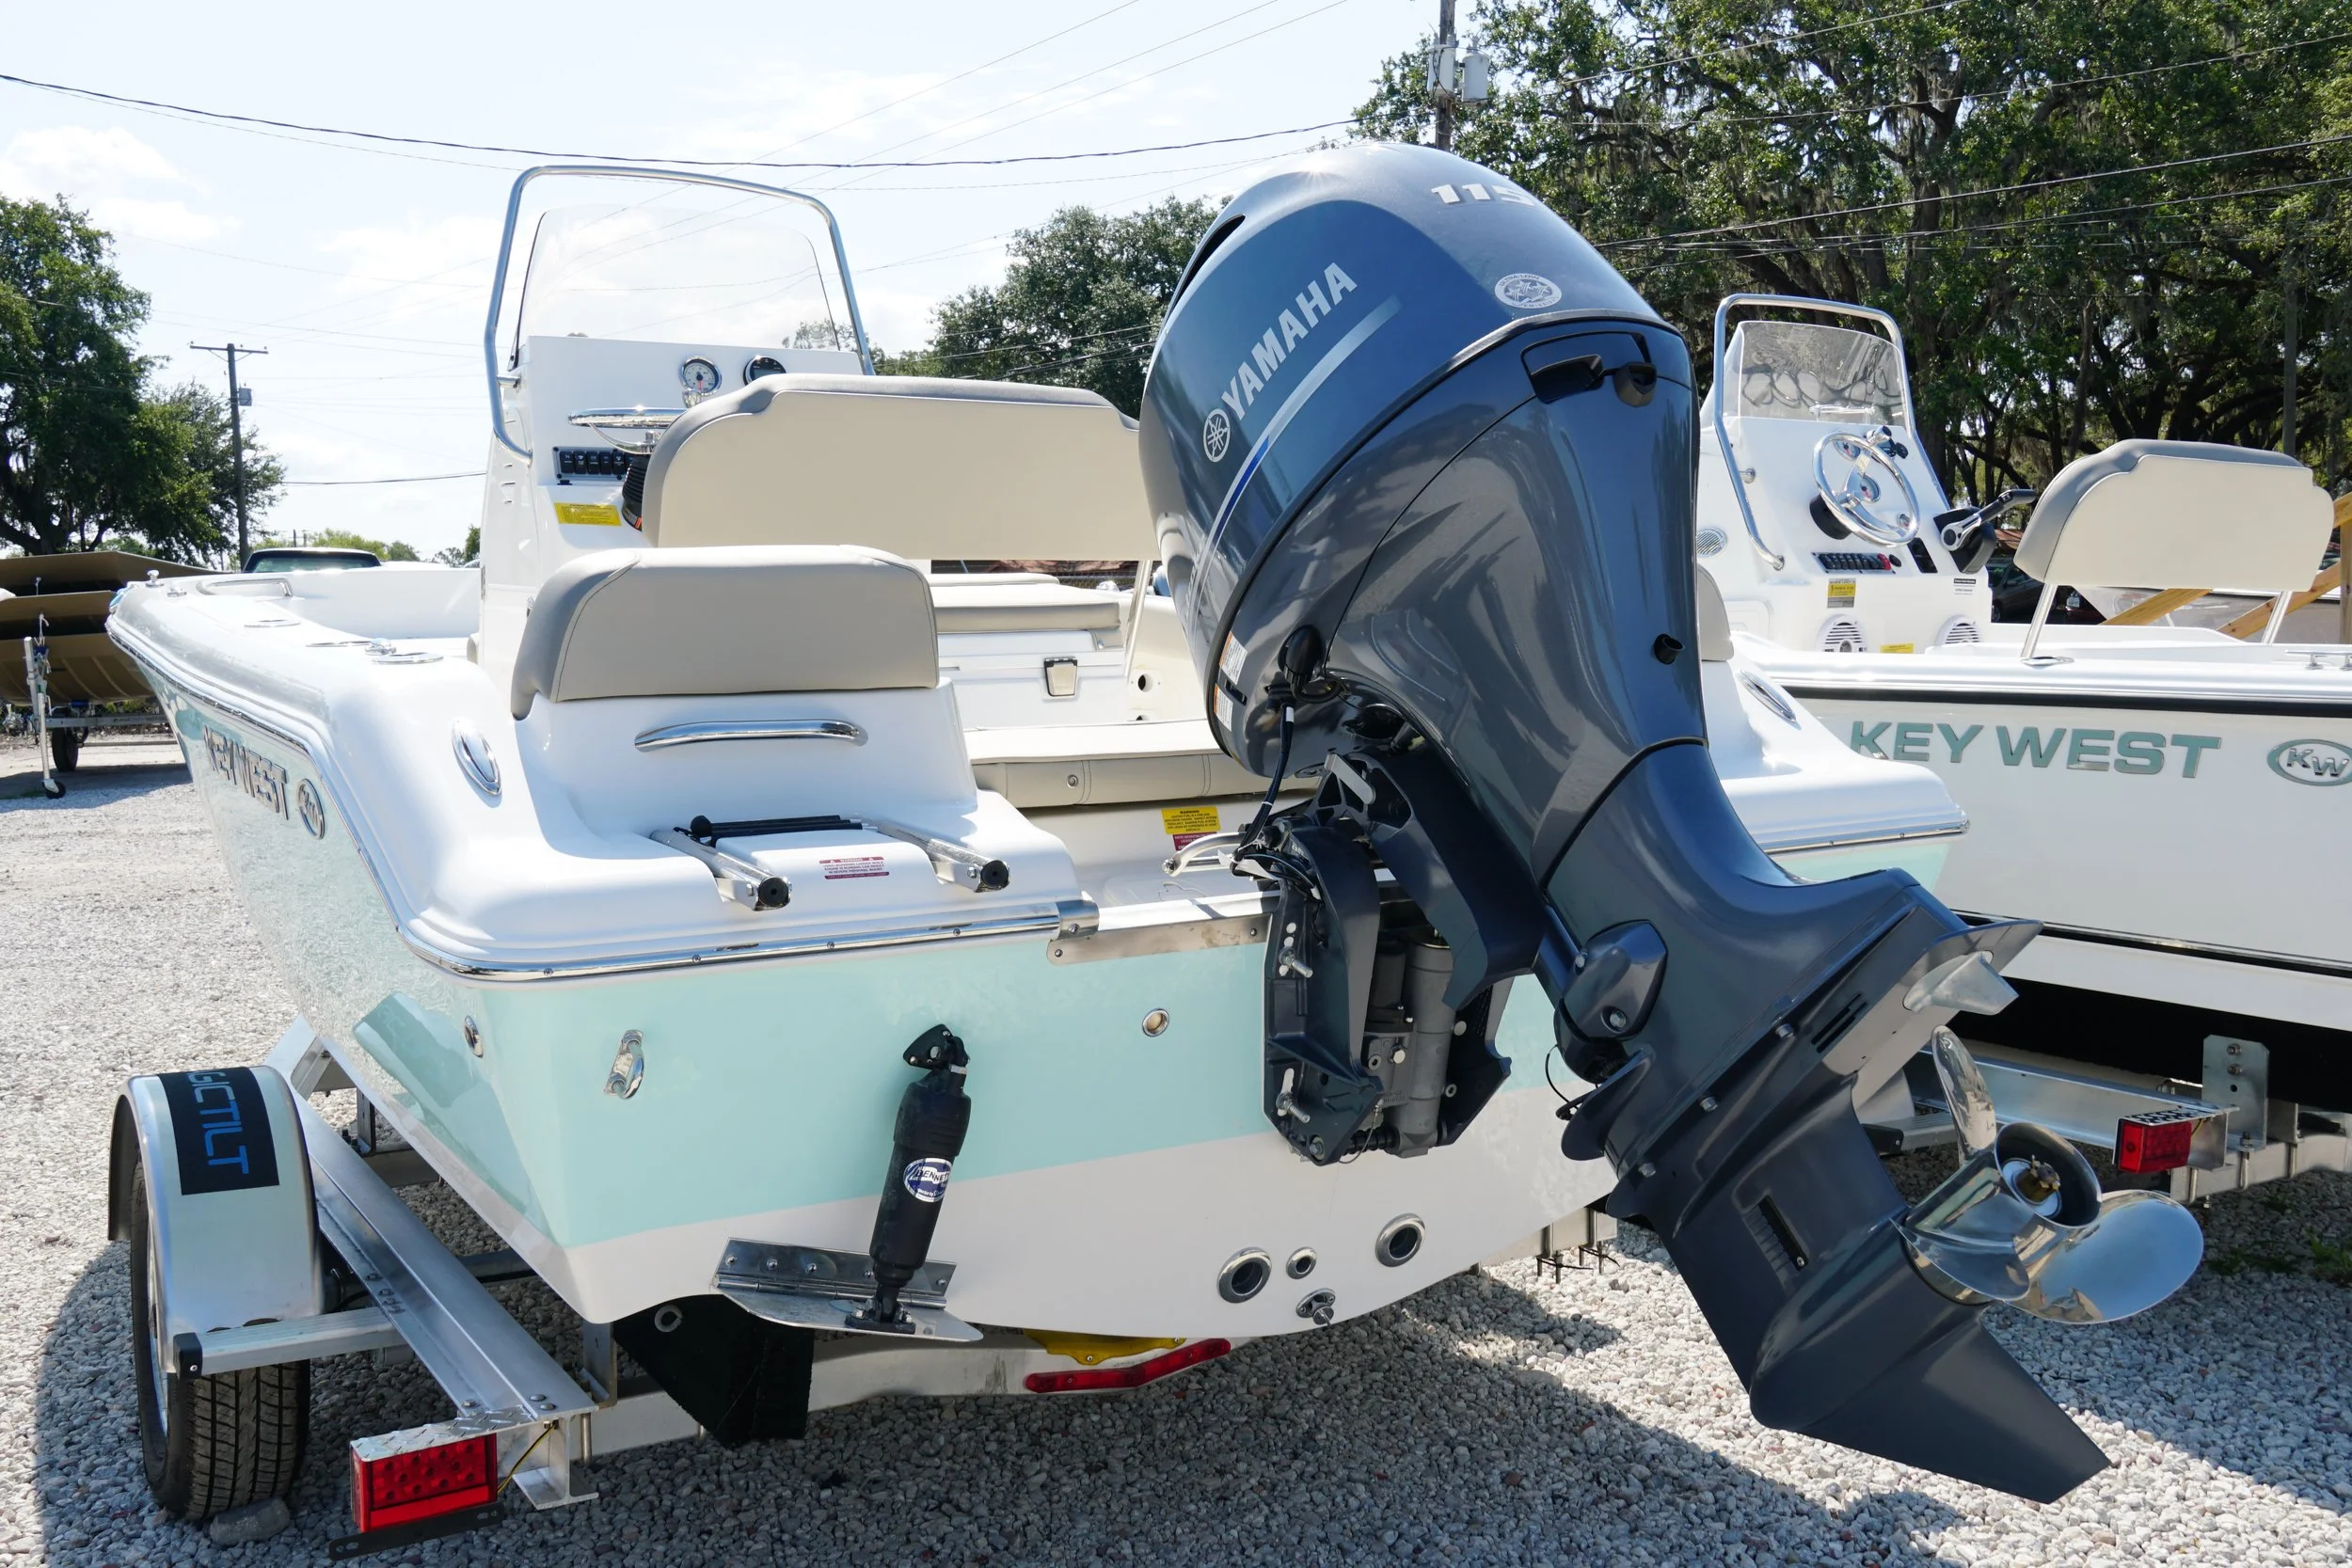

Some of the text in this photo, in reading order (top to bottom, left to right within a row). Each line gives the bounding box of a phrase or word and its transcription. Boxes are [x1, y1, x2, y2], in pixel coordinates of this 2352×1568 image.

[1431, 183, 1535, 206] 115
[1221, 262, 1359, 421] YAMAHA
[203, 724, 289, 821] KEY WEST
[1851, 721, 2222, 779] KEY WEST
[2286, 748, 2350, 778] KW
